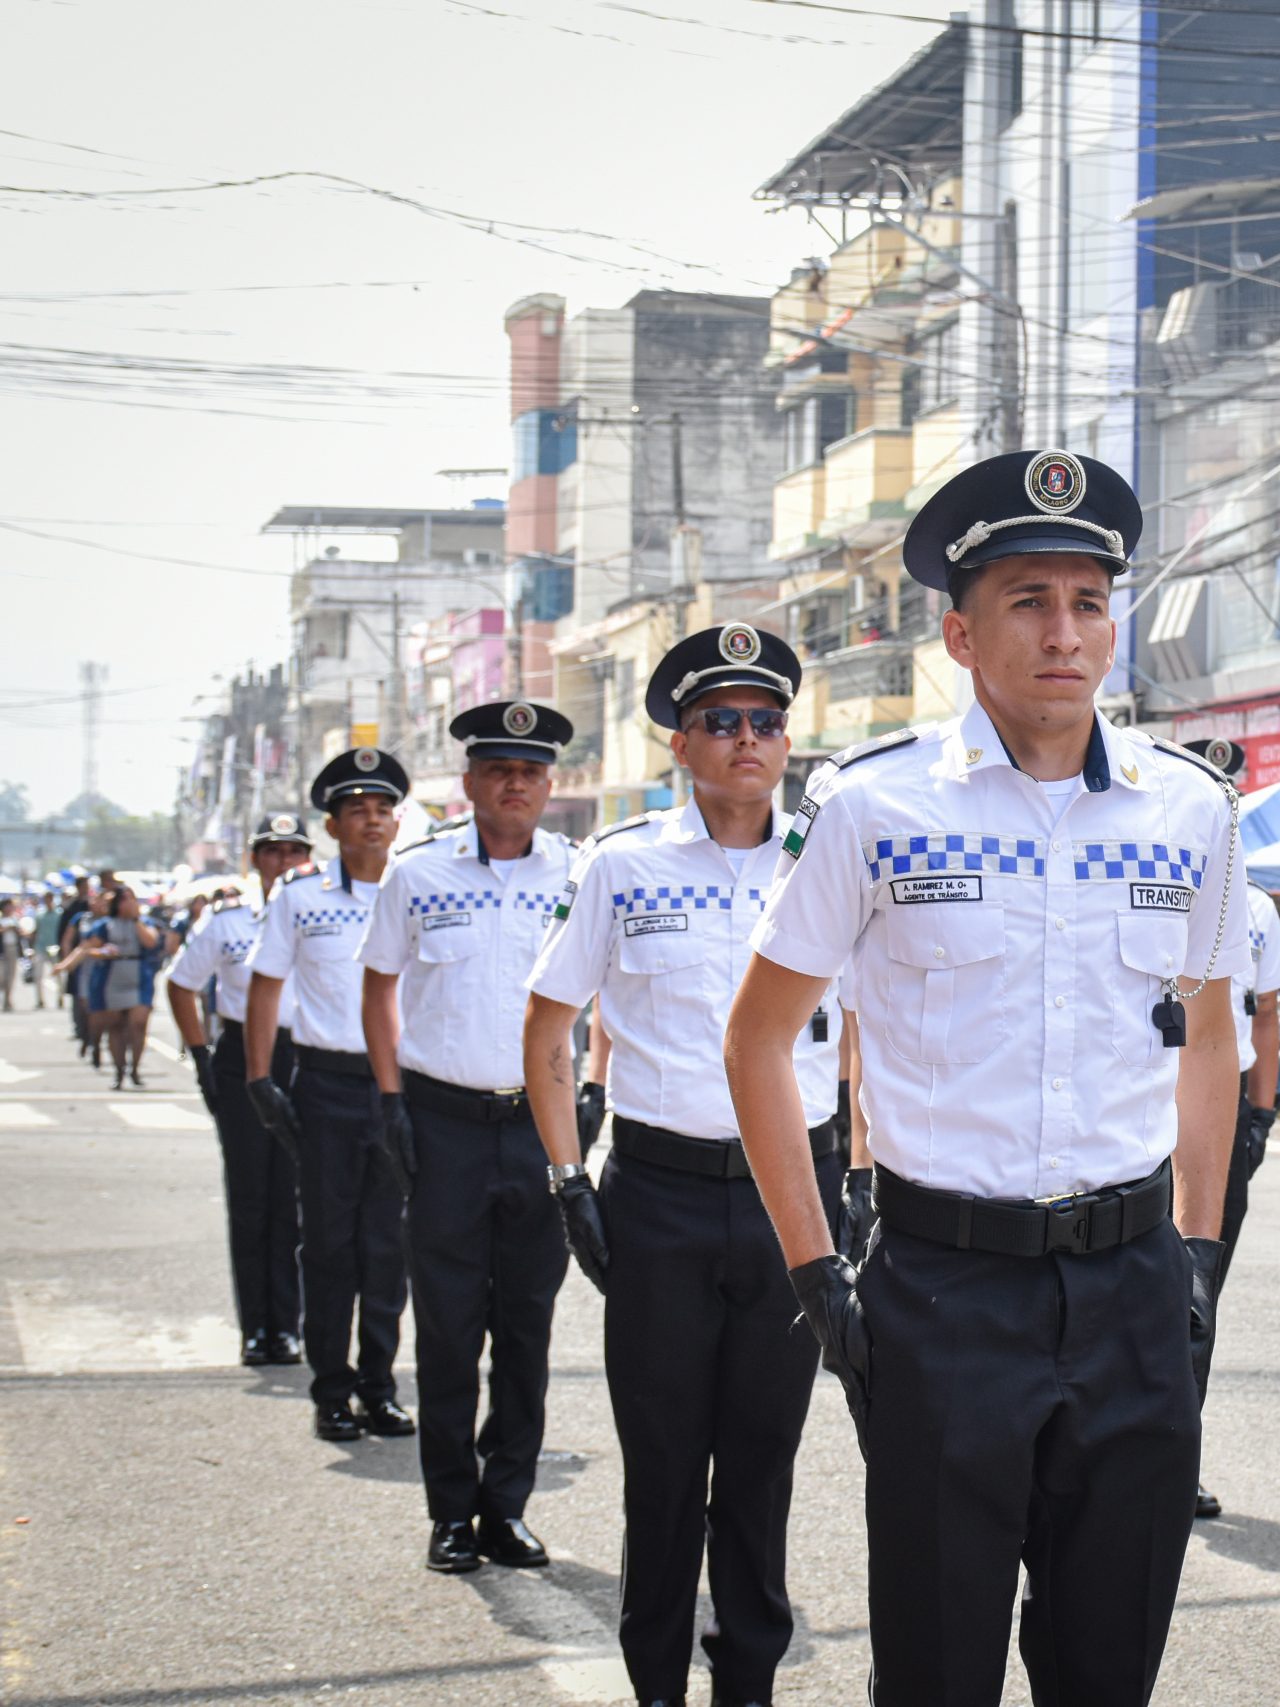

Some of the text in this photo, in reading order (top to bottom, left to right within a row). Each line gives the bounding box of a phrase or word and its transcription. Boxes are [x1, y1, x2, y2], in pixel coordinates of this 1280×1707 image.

[1040, 493, 1069, 507] MILAGRO
[904, 883, 910, 891] A.
[912, 882, 943, 891] RAMIREZ
[946, 881, 955, 889] M.
[904, 892, 925, 900] AGENTE
[1136, 888, 1191, 908] TRANSITO
